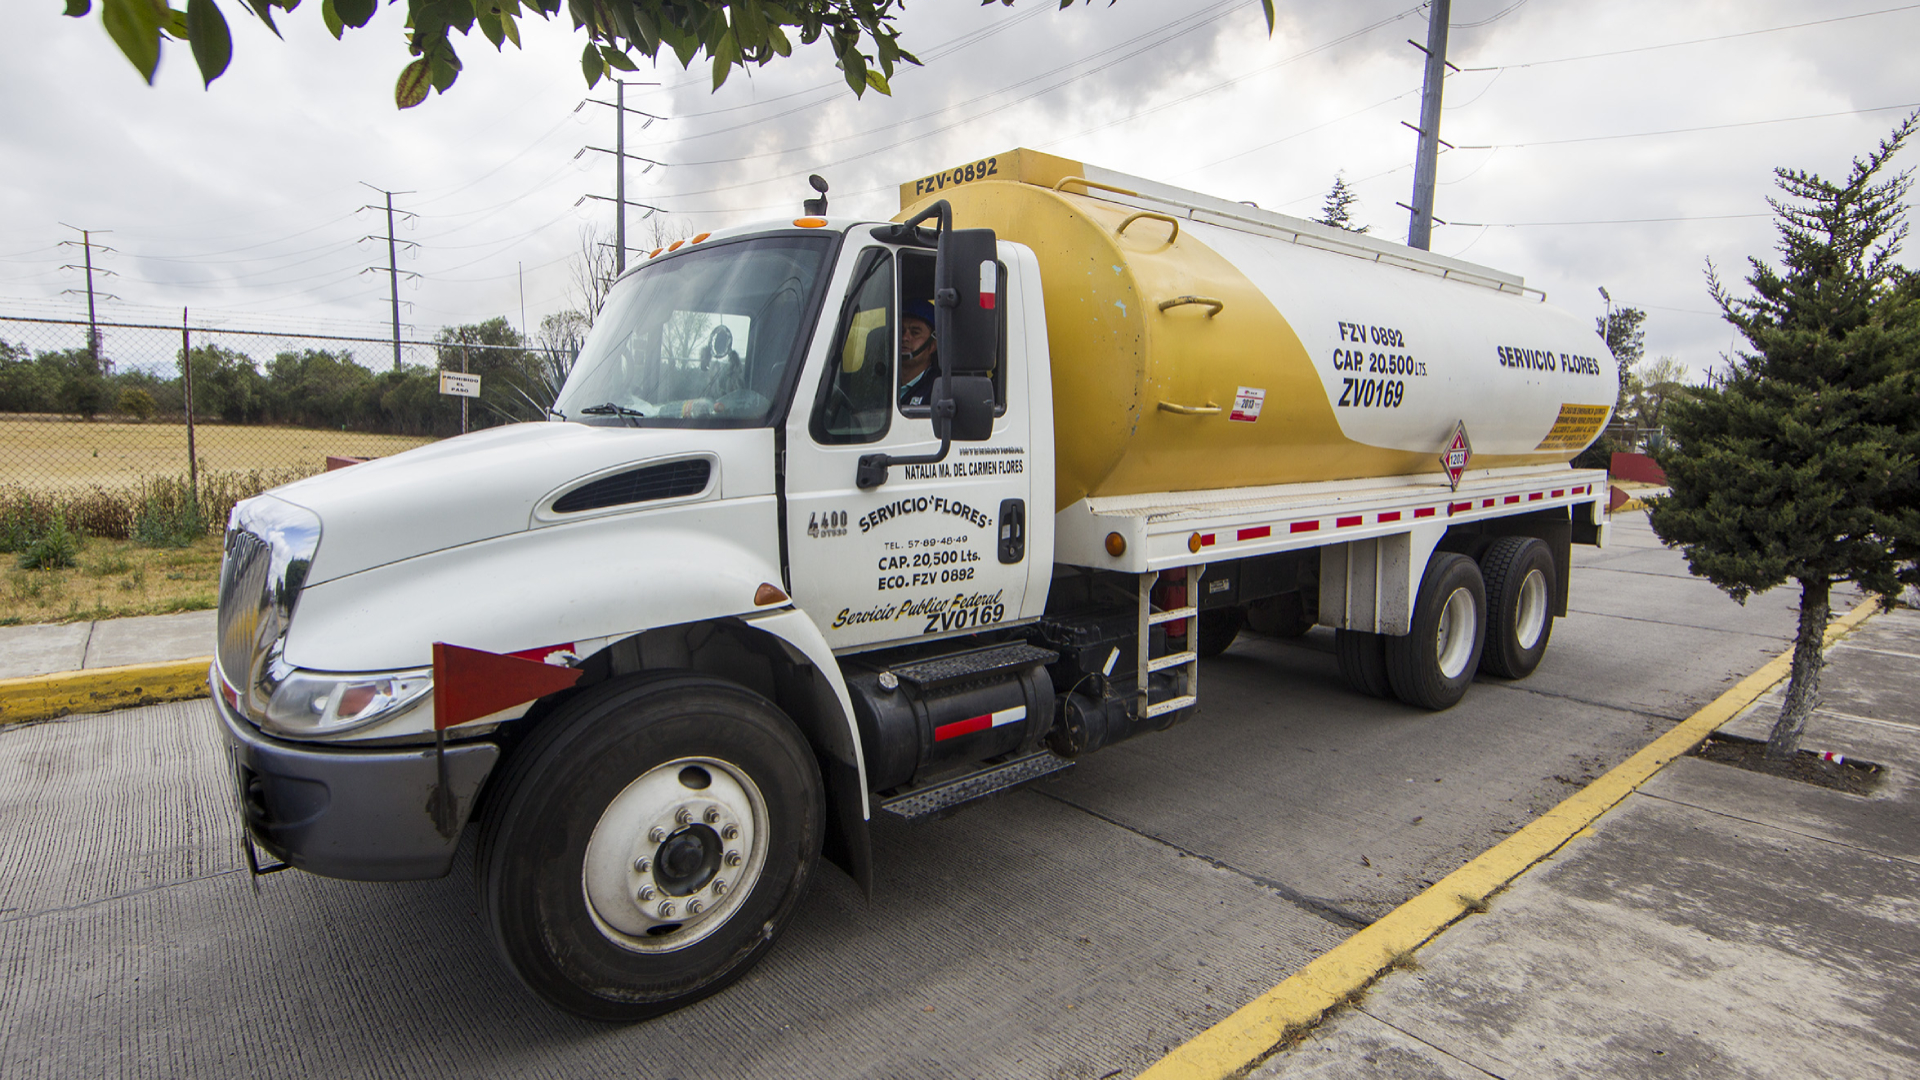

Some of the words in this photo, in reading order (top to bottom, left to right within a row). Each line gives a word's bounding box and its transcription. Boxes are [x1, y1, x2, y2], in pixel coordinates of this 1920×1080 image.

[916, 157, 998, 196] FZV-0892
[1338, 321, 1366, 343] FZV
[1370, 325, 1405, 348] 0892
[1333, 348, 1364, 372] CAP.
[1497, 345, 1556, 372] SERVICIO
[1560, 353, 1600, 376] FLORES
[442, 375, 479, 383] PROHIBIDO
[1338, 377, 1404, 408] ZV0169
[959, 446, 1025, 456] INTERNATIONAL
[1450, 453, 1463, 465] 1203
[905, 464, 938, 480] NATALIA
[939, 463, 952, 478] MA.
[953, 462, 967, 477] DEL
[968, 461, 997, 476] CARMEN
[998, 459, 1023, 474] FLORES
[807, 510, 848, 538] 4400
[859, 497, 928, 533] SERVICIO
[884, 542, 904, 550] TEL.
[878, 555, 910, 571] CAP.
[913, 550, 958, 568] 20,500
[960, 549, 981, 563] Lts.
[878, 575, 910, 591] ECO.
[912, 571, 937, 587] FZV
[940, 567, 975, 583] 0892
[831, 603, 897, 630] Servicio
[894, 596, 951, 621] Publico
[948, 589, 1003, 613] Federal
[923, 603, 1005, 634] ZV0169
